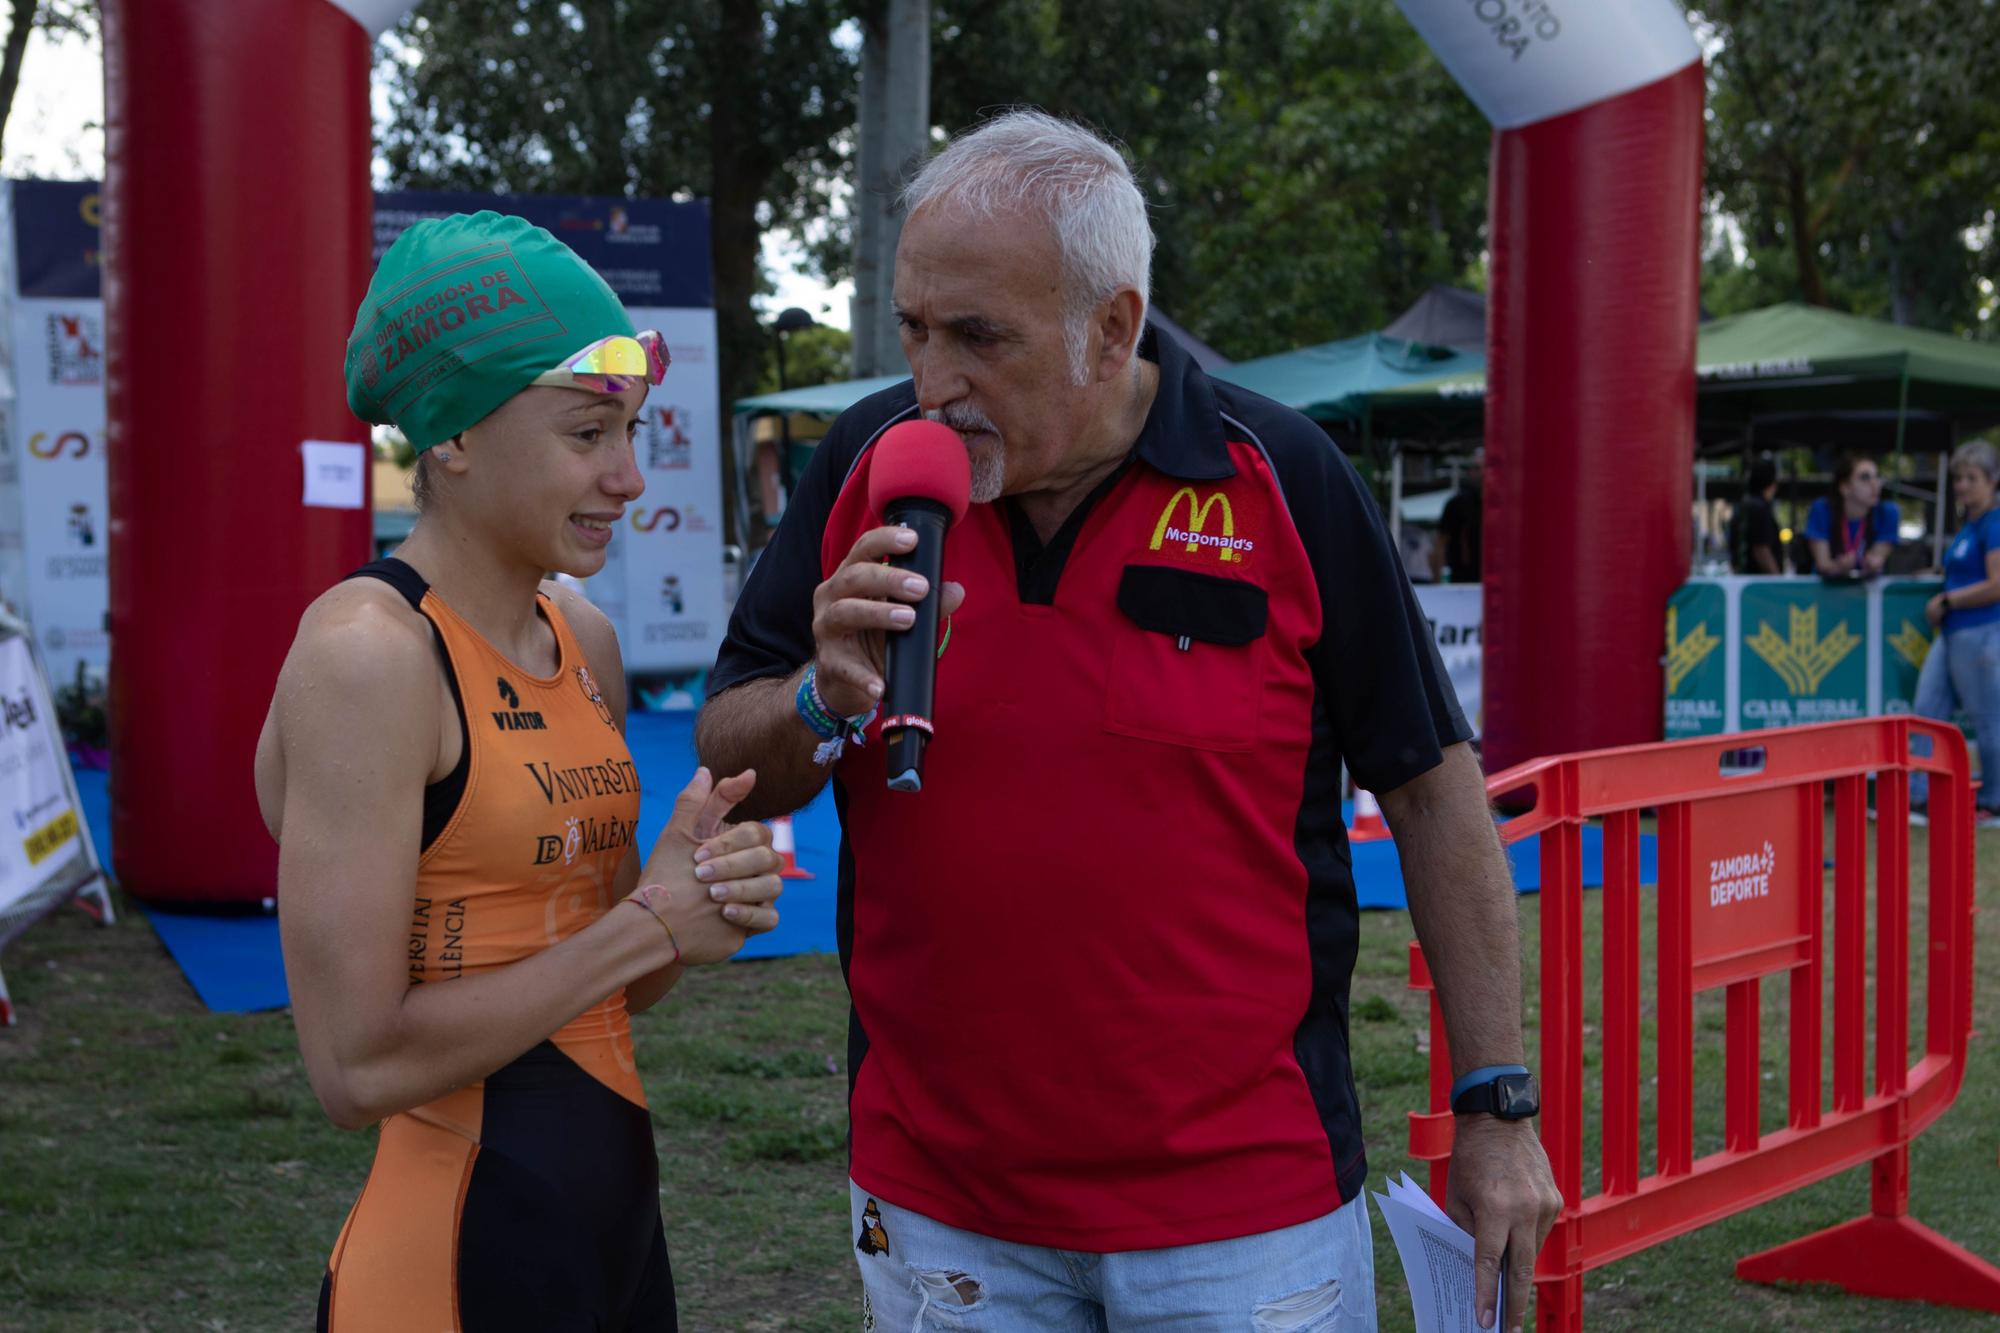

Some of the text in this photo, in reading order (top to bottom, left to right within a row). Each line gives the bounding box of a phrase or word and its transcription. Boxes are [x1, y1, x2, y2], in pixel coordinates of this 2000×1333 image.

[375, 270, 511, 347] DIPUTACIÓN DE
[380, 286, 528, 374] ZAMORA
[1165, 526, 1254, 552] McDonald's
[491, 711, 548, 732] VIATOR
[1710, 873, 1769, 908] DEPORTE
